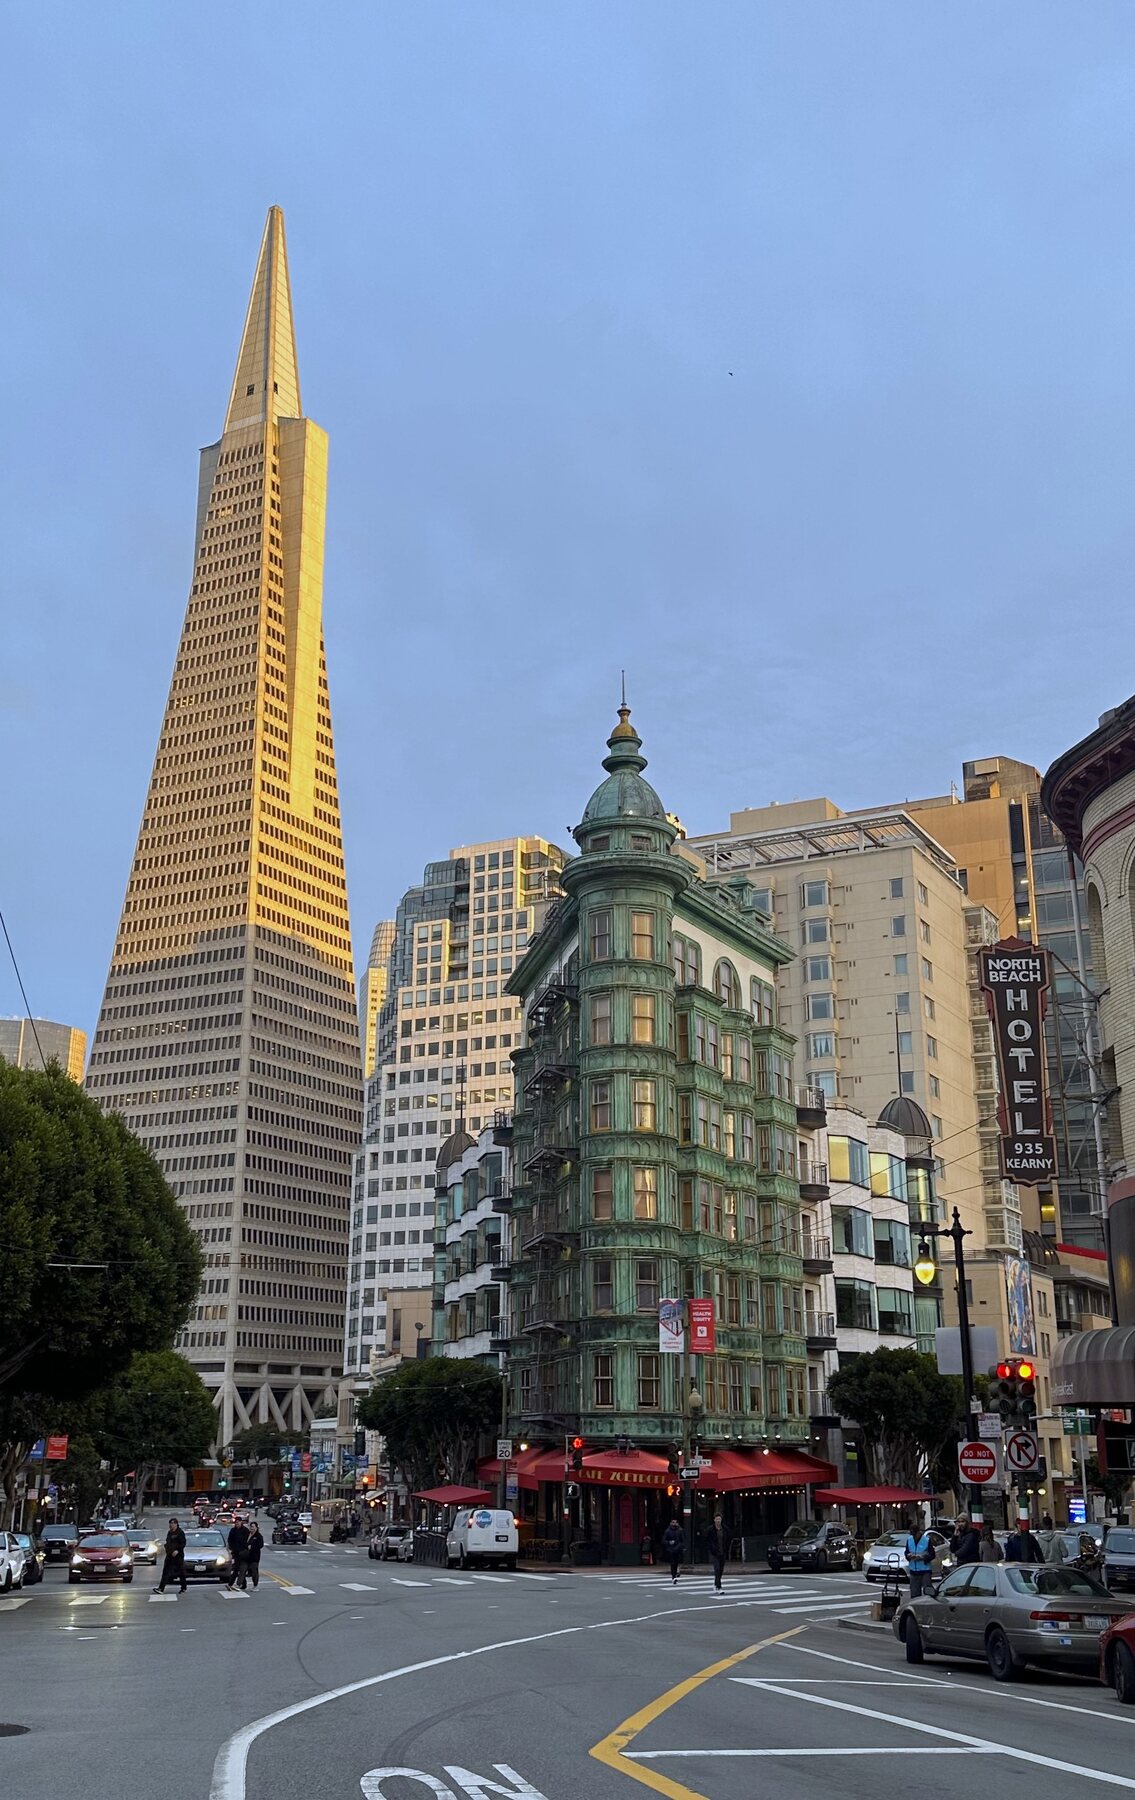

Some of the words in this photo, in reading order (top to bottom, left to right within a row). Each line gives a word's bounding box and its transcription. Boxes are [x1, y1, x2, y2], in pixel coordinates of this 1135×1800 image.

[988, 959, 1040, 970] NORTH
[989, 971, 1041, 982] BEACH
[1006, 989, 1040, 1135] HOTEL
[1014, 1142, 1044, 1155] 935
[1006, 1158, 1053, 1170] KEARNY
[499, 1449, 511, 1458] 20
[579, 1469, 603, 1480] CAFE
